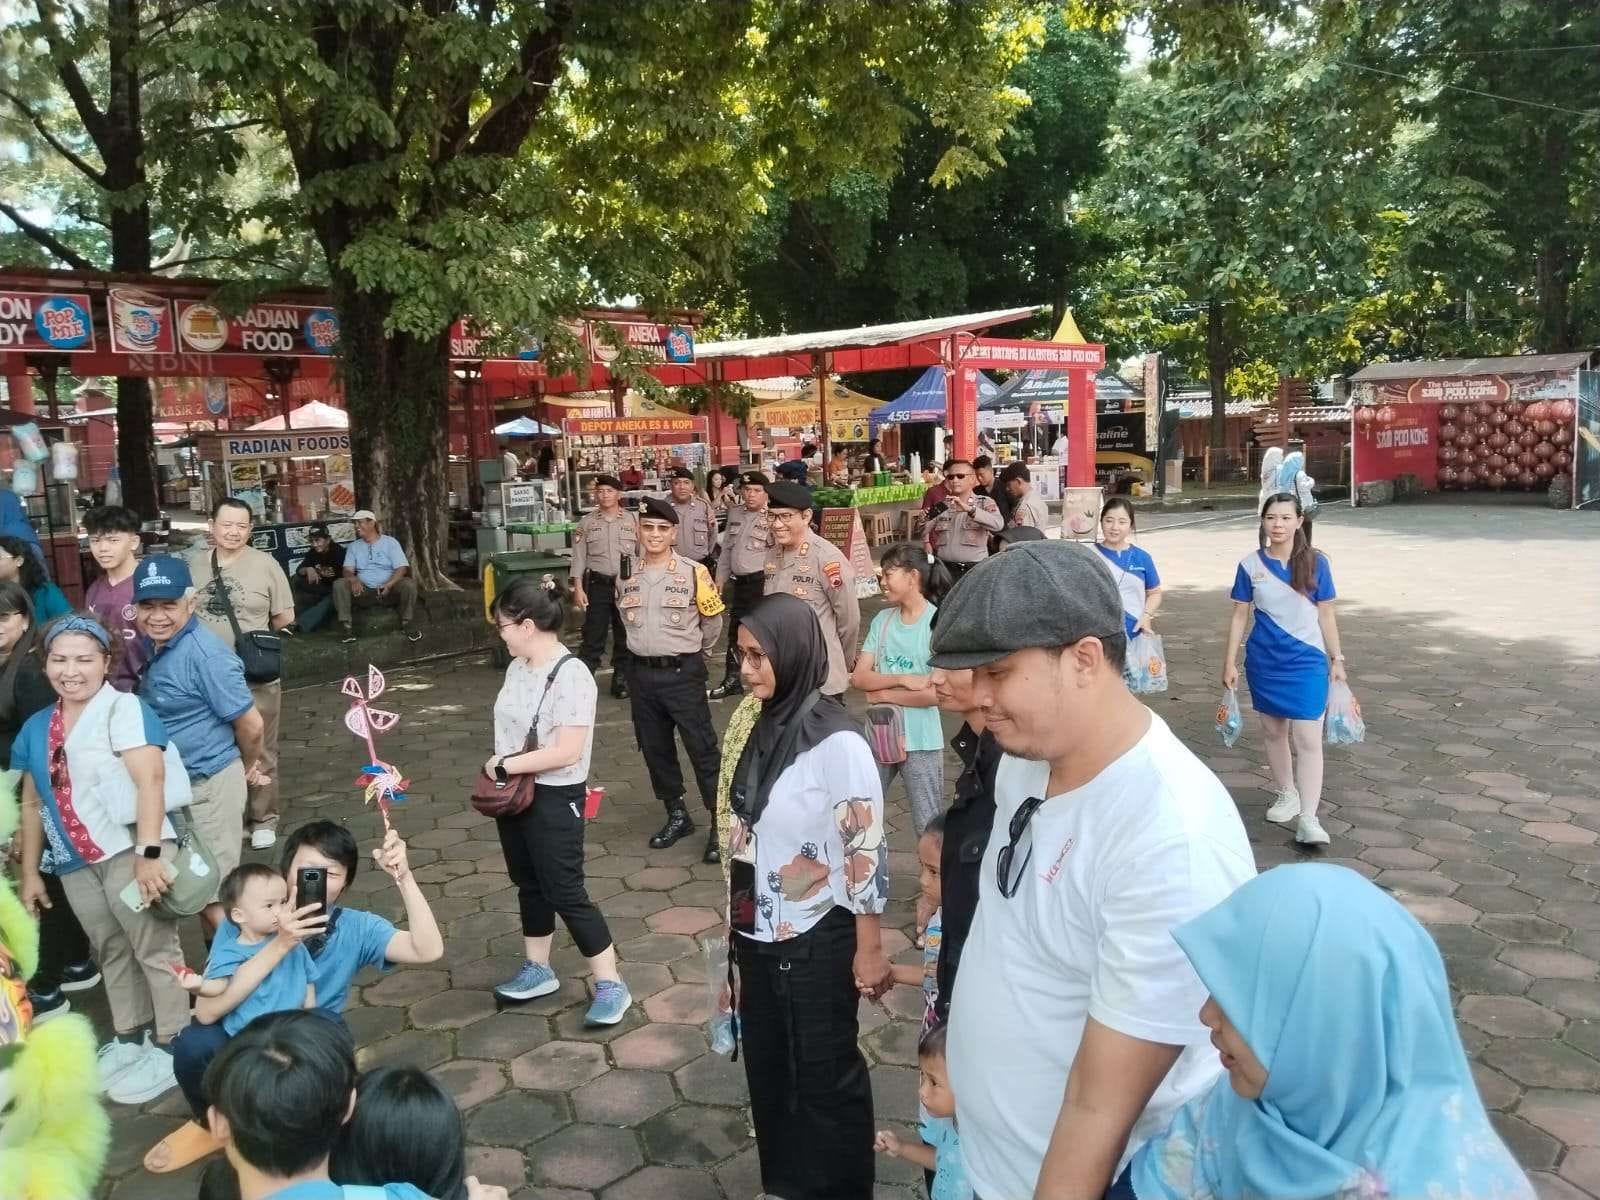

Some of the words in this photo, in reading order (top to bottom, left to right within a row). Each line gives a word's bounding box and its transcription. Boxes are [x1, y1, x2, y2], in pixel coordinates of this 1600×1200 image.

[628, 325, 661, 343] ANEKA
[241, 331, 294, 351] FOOD
[1443, 380, 1463, 388] Great
[1464, 378, 1493, 387] Temple
[159, 403, 193, 417] KASIR
[581, 421, 614, 432] DEPOT
[615, 420, 648, 431] ANEKA
[649, 420, 662, 430] ES
[663, 420, 670, 430] &
[672, 419, 693, 430] KOPI
[230, 439, 291, 454] RADIAN
[298, 436, 350, 450] FOODS
[139, 578, 171, 588] TORONTO
[792, 575, 815, 584] POLRI
[665, 586, 689, 595] POLRI
